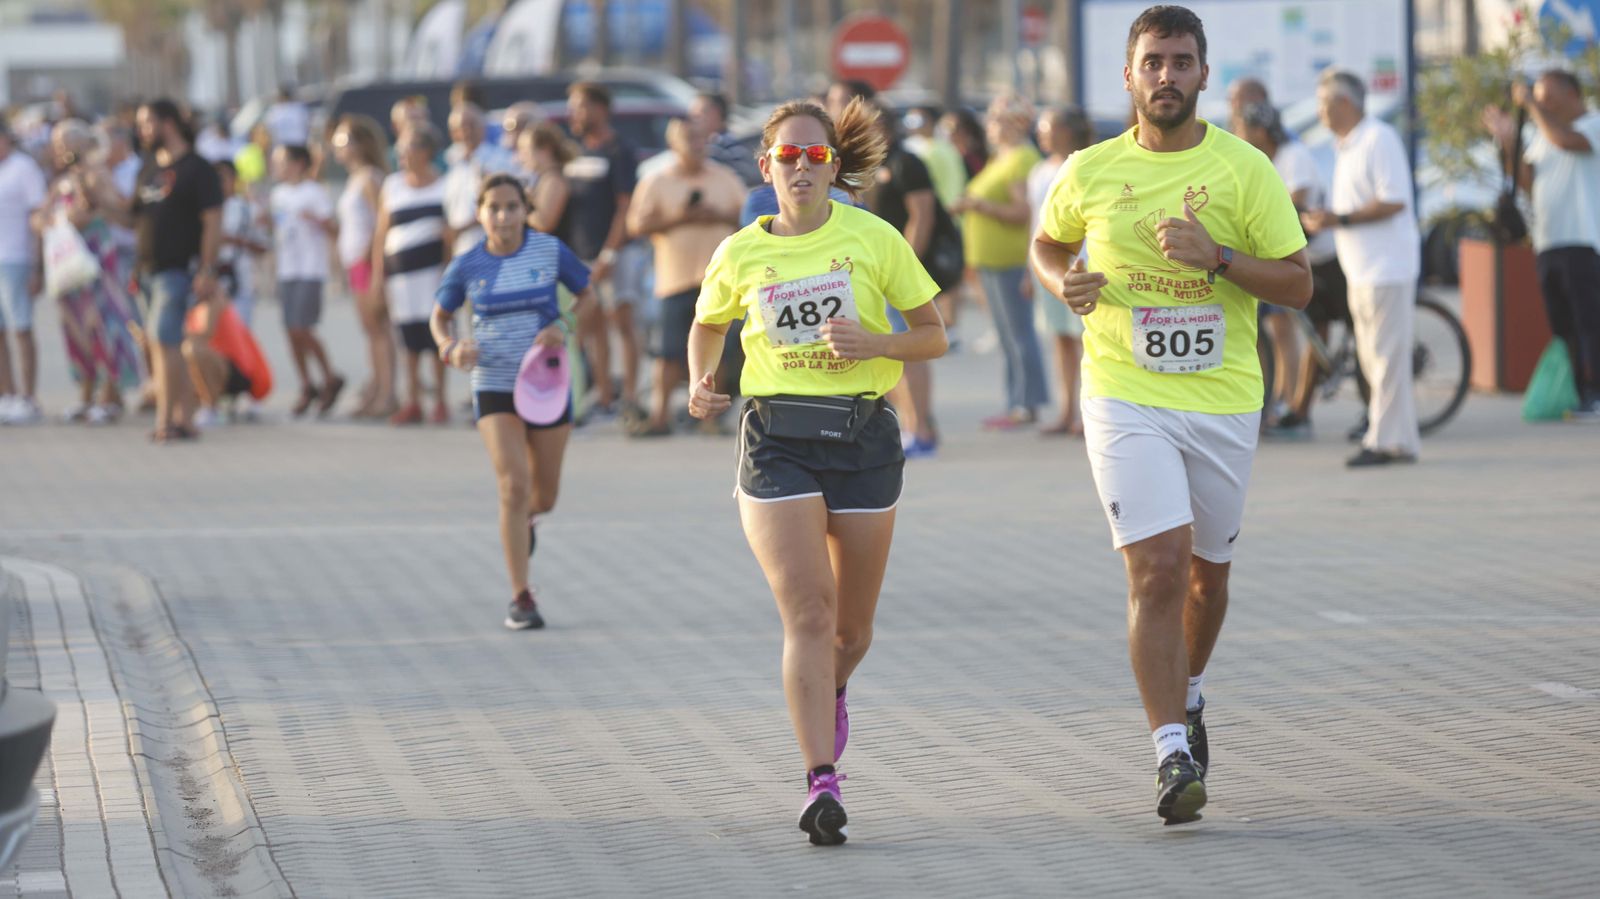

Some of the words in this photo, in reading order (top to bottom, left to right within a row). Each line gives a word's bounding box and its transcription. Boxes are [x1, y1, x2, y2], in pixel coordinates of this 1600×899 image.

[1128, 272, 1146, 281] VII
[1150, 275, 1207, 289] CARRERA
[774, 290, 796, 301] POR
[797, 288, 810, 297] LA
[812, 281, 847, 292] MUJER
[1128, 283, 1153, 291] POR
[1156, 285, 1169, 295] LA
[1173, 286, 1213, 299] MUJER
[776, 295, 846, 330] 482
[1160, 307, 1209, 315] CARRER
[1149, 316, 1172, 325] POR
[1188, 314, 1221, 324] MUJER
[1145, 328, 1215, 358] 805
[782, 351, 799, 360] VII
[802, 351, 842, 361] CARR
[783, 360, 806, 370] POR
[808, 360, 823, 369] LA
[827, 358, 856, 371] MUJE
[820, 430, 842, 438] SPORT
